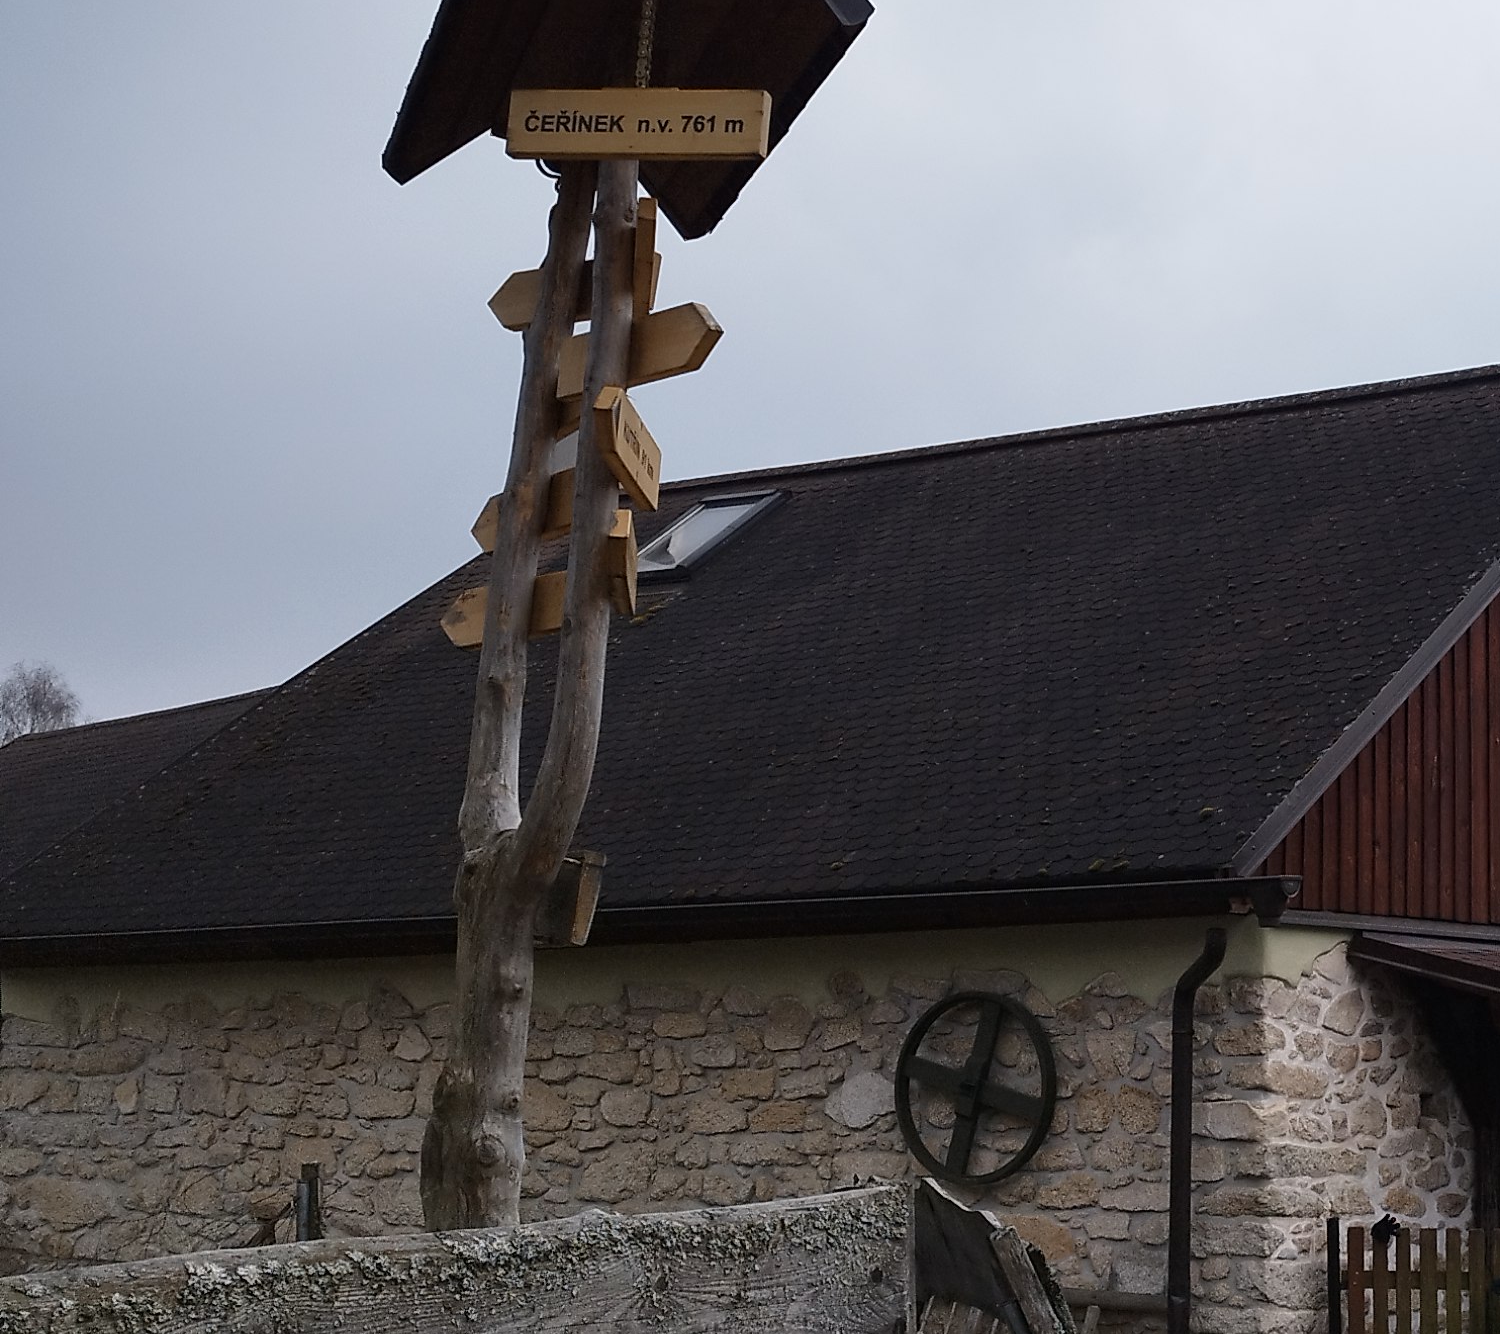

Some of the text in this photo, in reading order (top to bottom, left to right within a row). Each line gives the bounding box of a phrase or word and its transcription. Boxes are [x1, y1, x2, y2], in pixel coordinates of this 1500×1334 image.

[524, 110, 744, 134] ČEŘÍNEK n.v. 761 m
